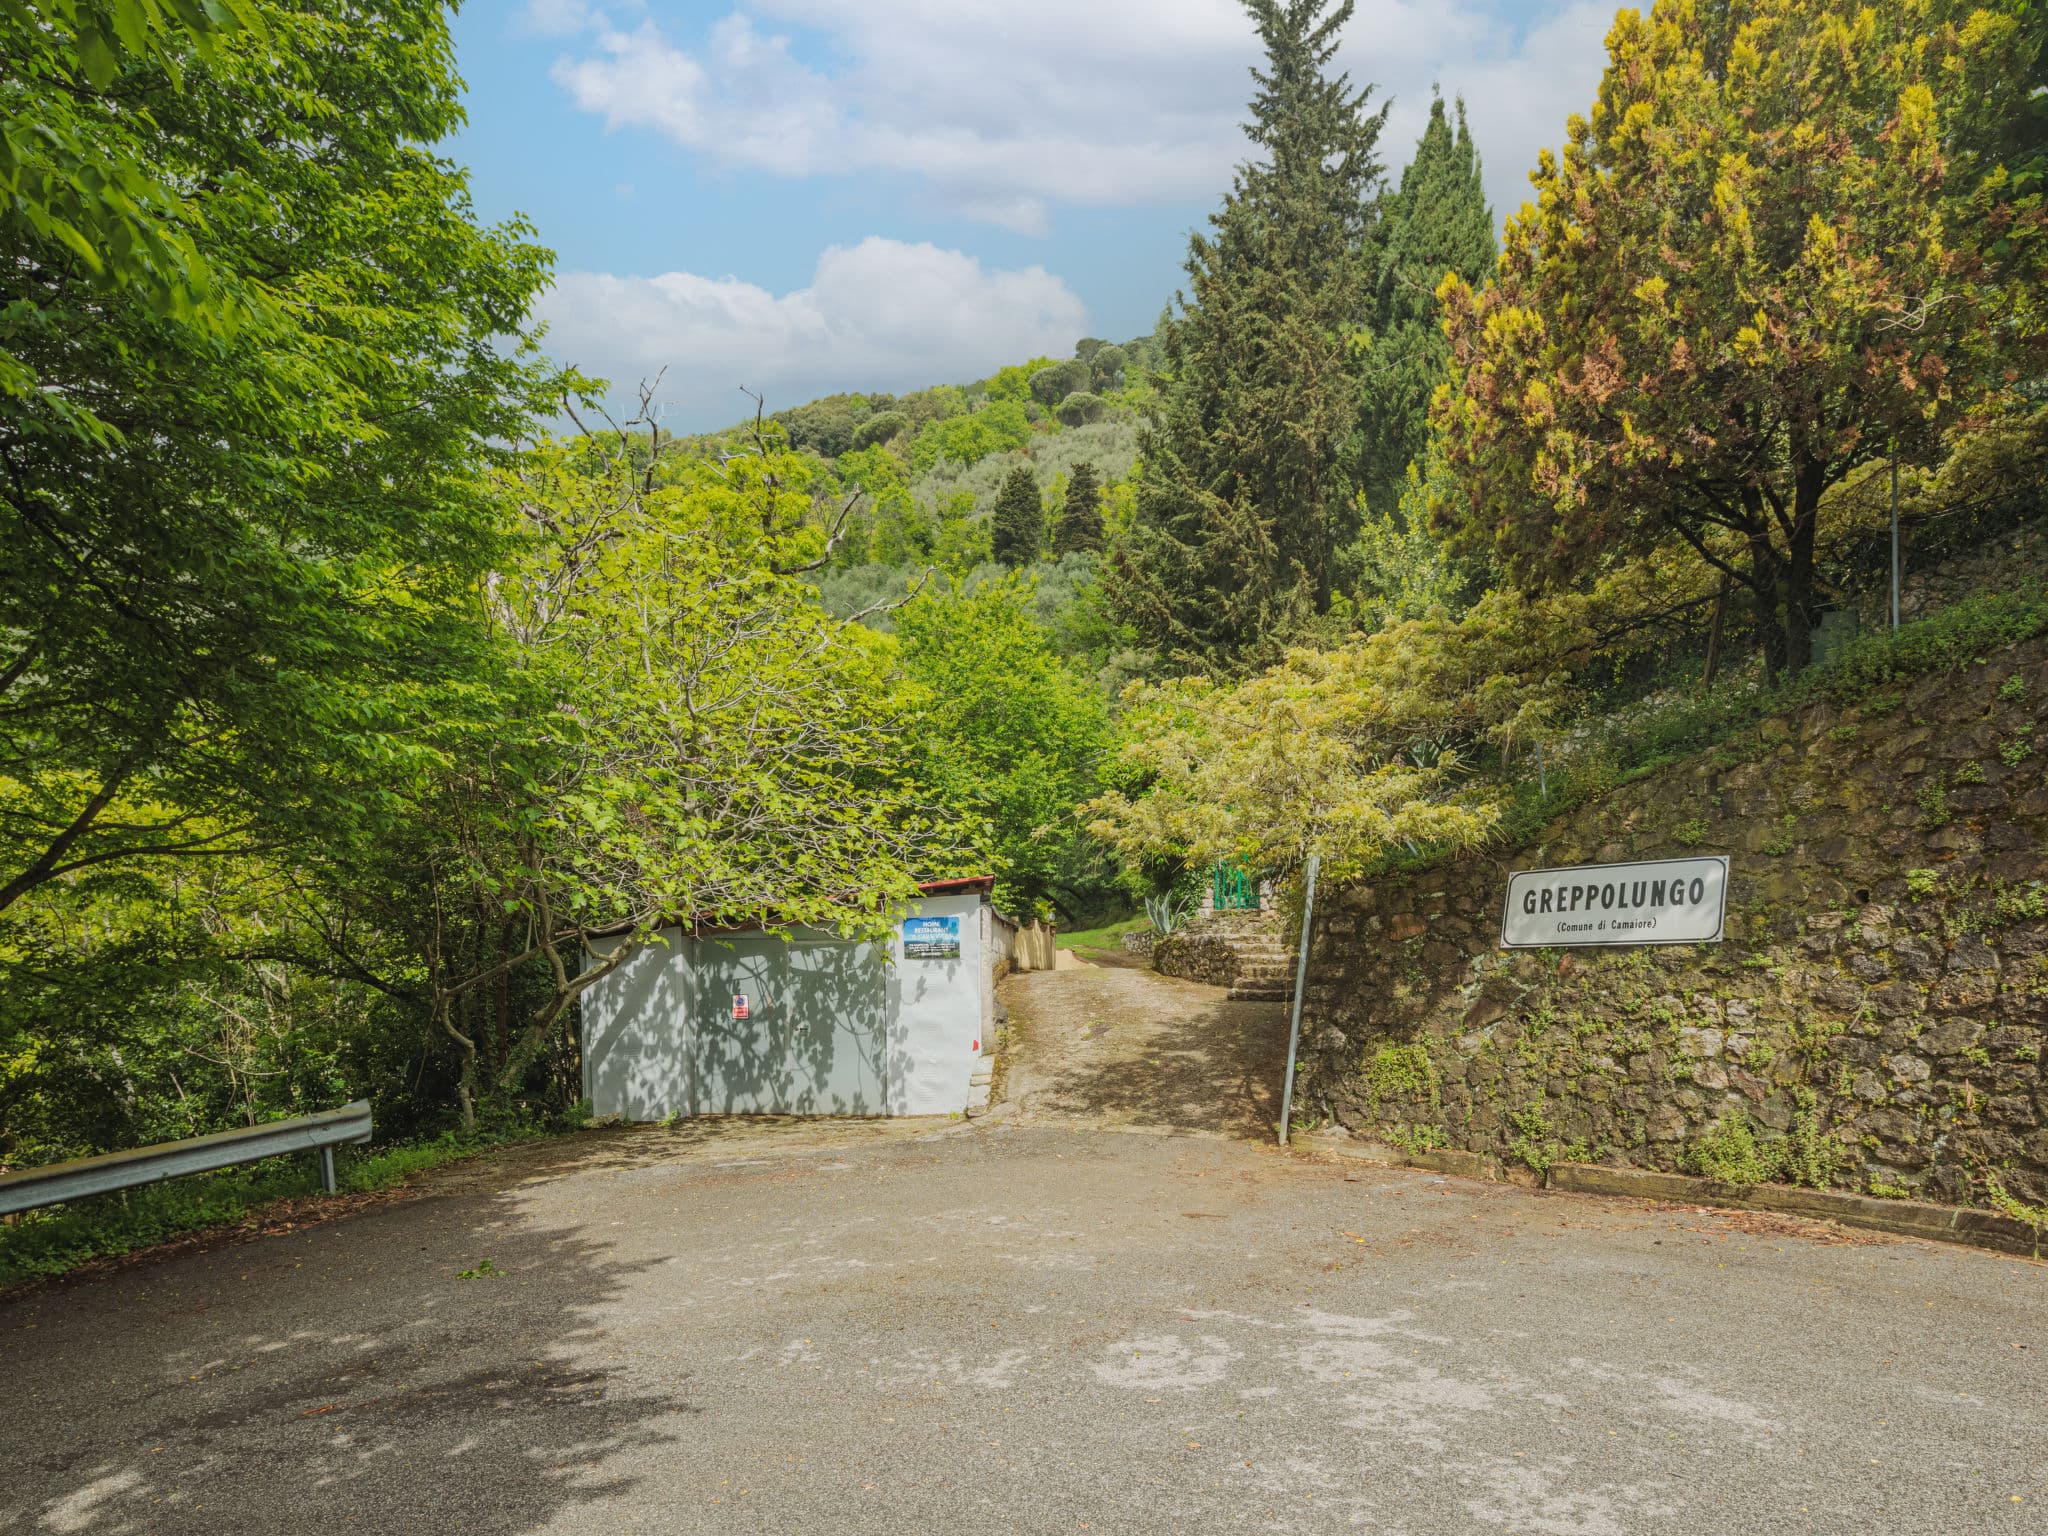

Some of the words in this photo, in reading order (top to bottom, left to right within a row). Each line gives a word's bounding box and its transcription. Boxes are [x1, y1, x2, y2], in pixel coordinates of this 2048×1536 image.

[1523, 877, 1704, 914] GREPPOLUNGO
[1556, 921, 1593, 933] (Comune
[1598, 920, 1606, 930] di
[1611, 917, 1657, 930] Camaiore)
